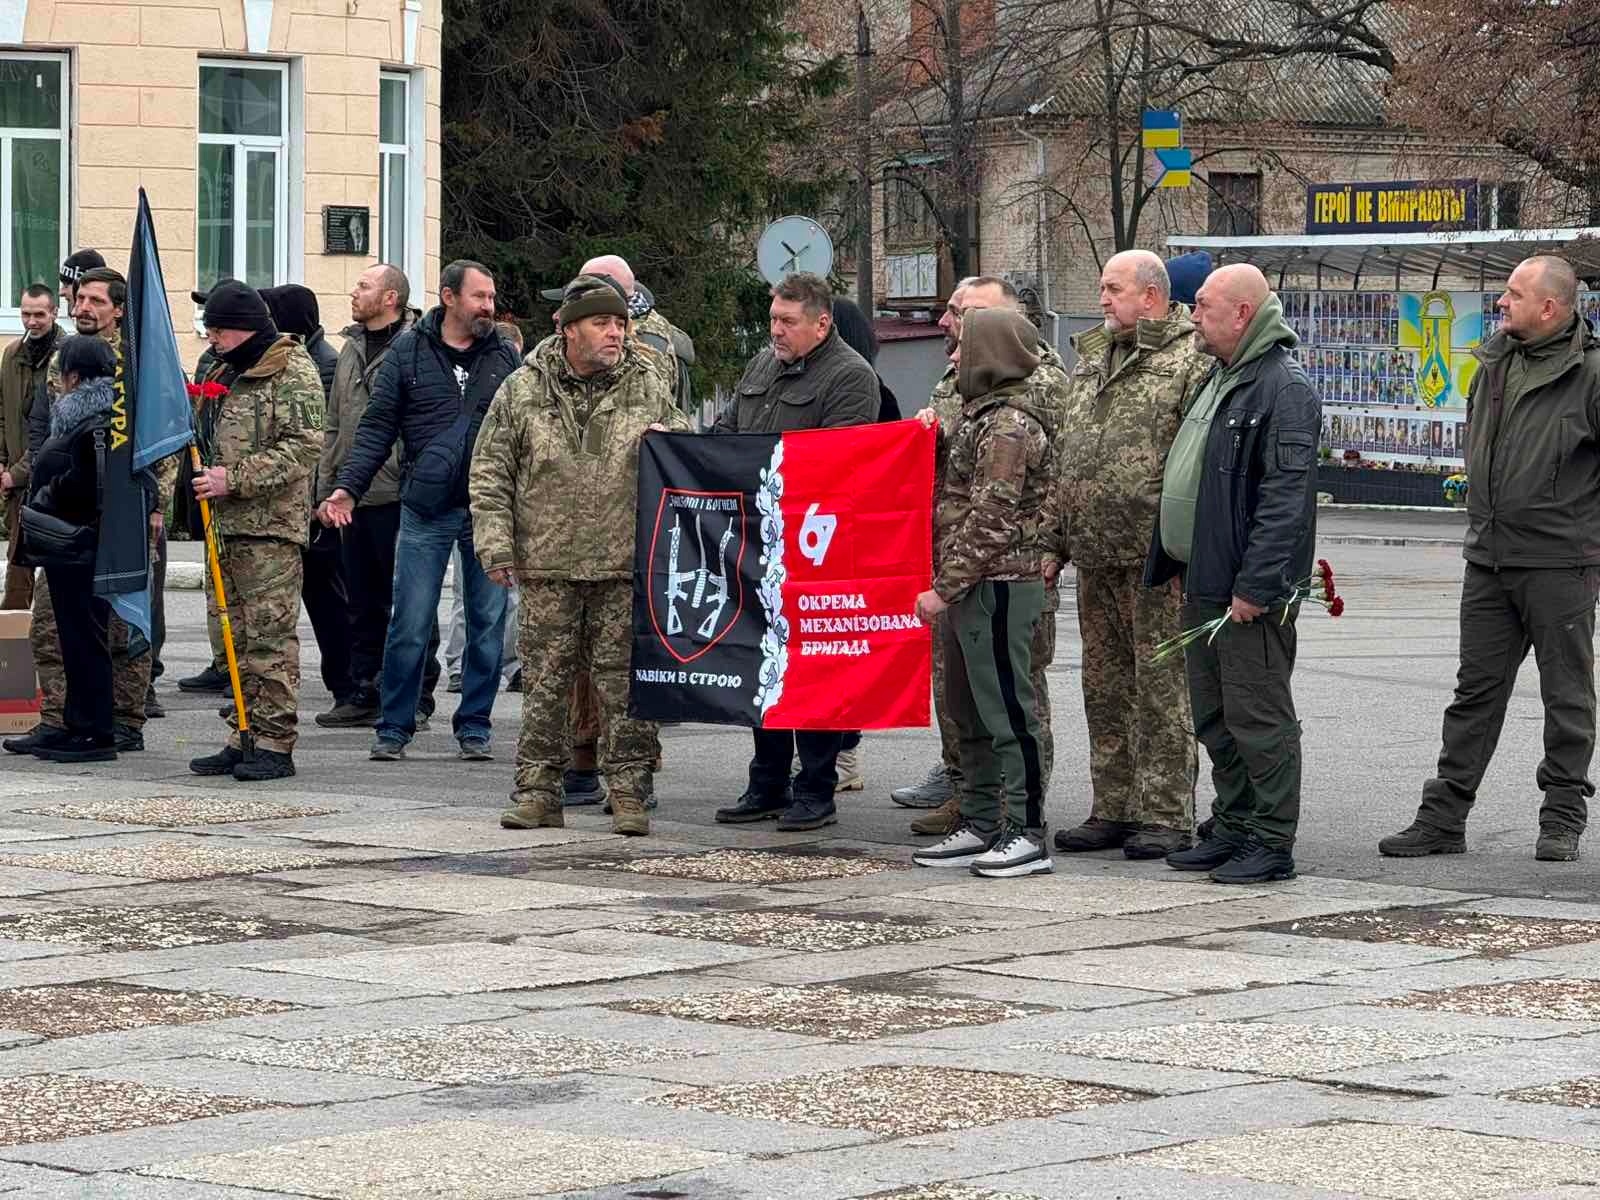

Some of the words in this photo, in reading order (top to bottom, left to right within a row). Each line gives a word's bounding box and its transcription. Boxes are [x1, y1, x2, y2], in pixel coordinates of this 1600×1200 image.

[1315, 186, 1351, 223] ГЕРОЇ
[1356, 191, 1373, 223] НЕ
[798, 594, 866, 611] ОКРЕМА
[801, 640, 870, 656] БРИГАДА
[636, 669, 676, 683] НАВІКИ
[678, 672, 687, 683] В
[689, 672, 742, 688] СТРОЮ
